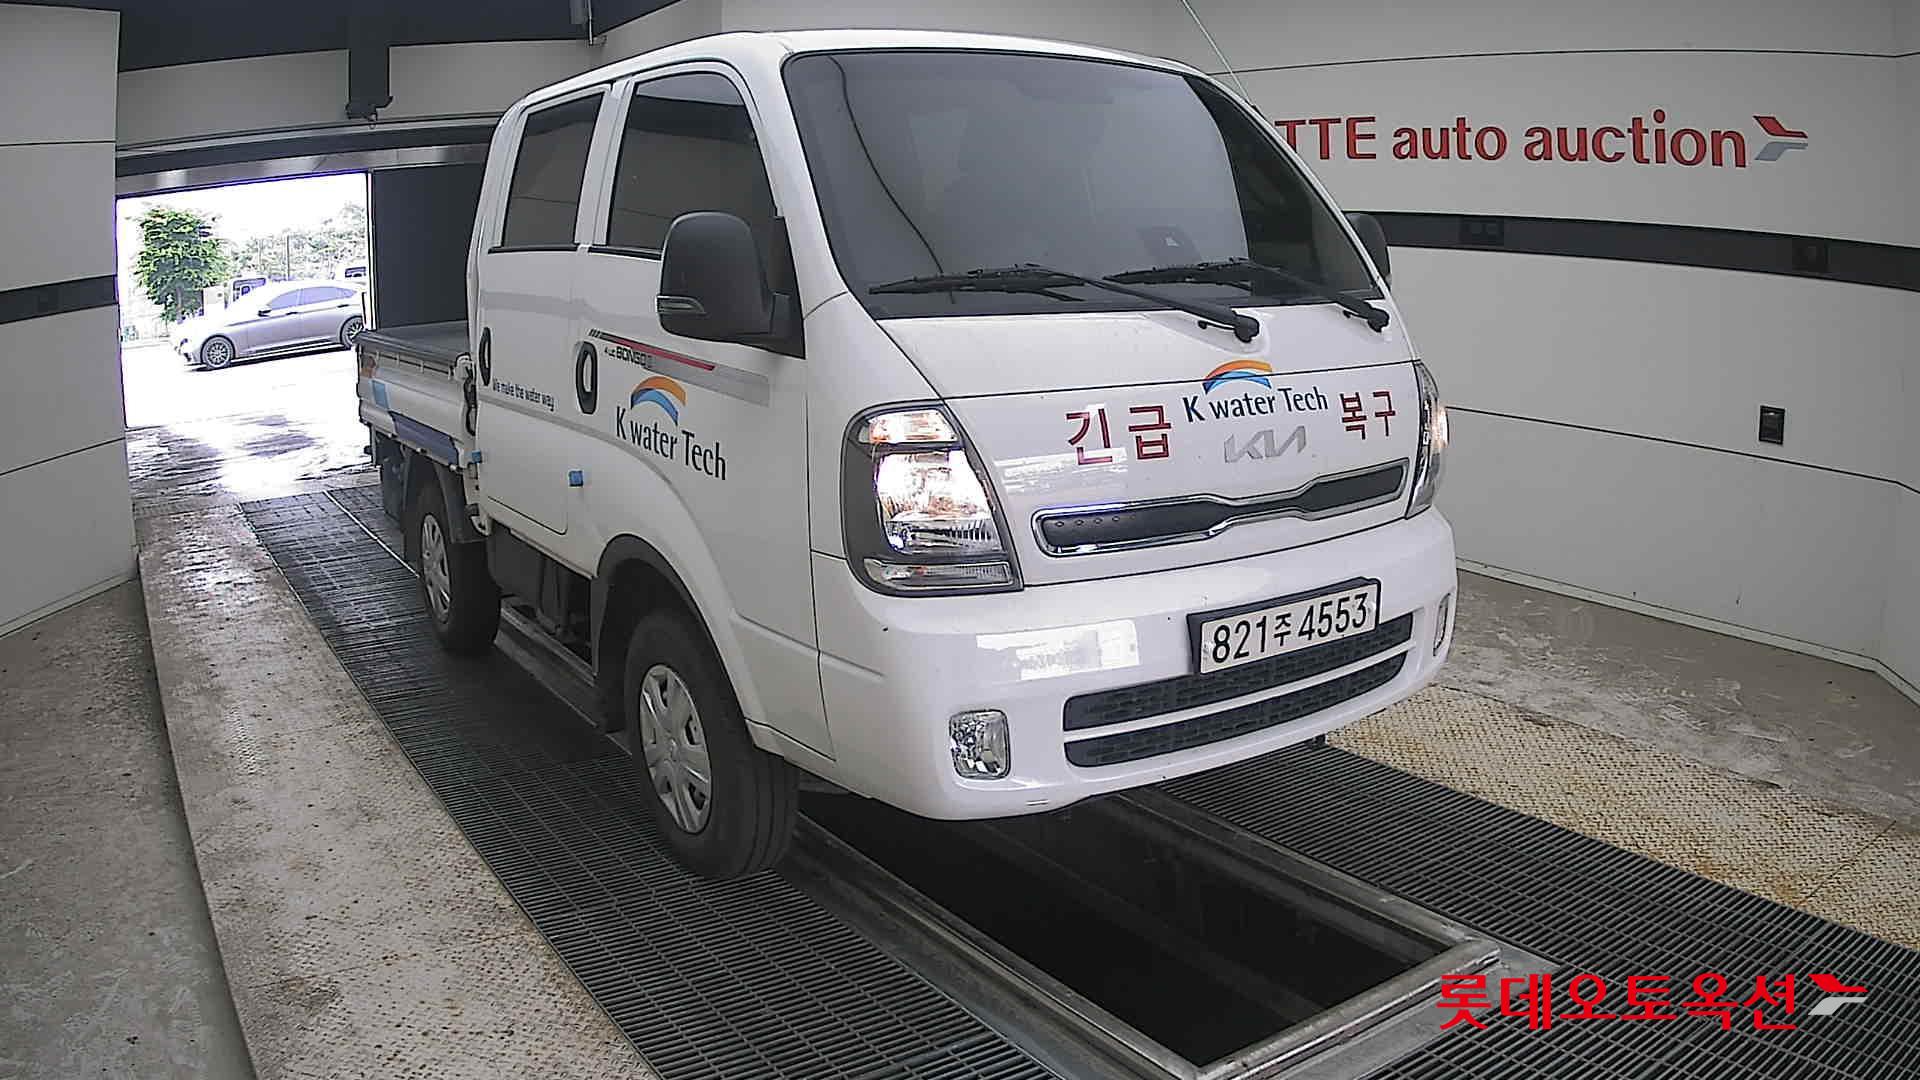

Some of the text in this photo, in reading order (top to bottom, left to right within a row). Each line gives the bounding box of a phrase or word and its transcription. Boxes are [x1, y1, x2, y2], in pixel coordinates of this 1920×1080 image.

[1392, 116, 1508, 161] auto
[1523, 109, 1747, 168] auction
[1182, 386, 1328, 423] K water Tech
[1340, 389, 1397, 441] 복구
[616, 406, 727, 480] K water Tech
[1065, 404, 1172, 466] 긴급
